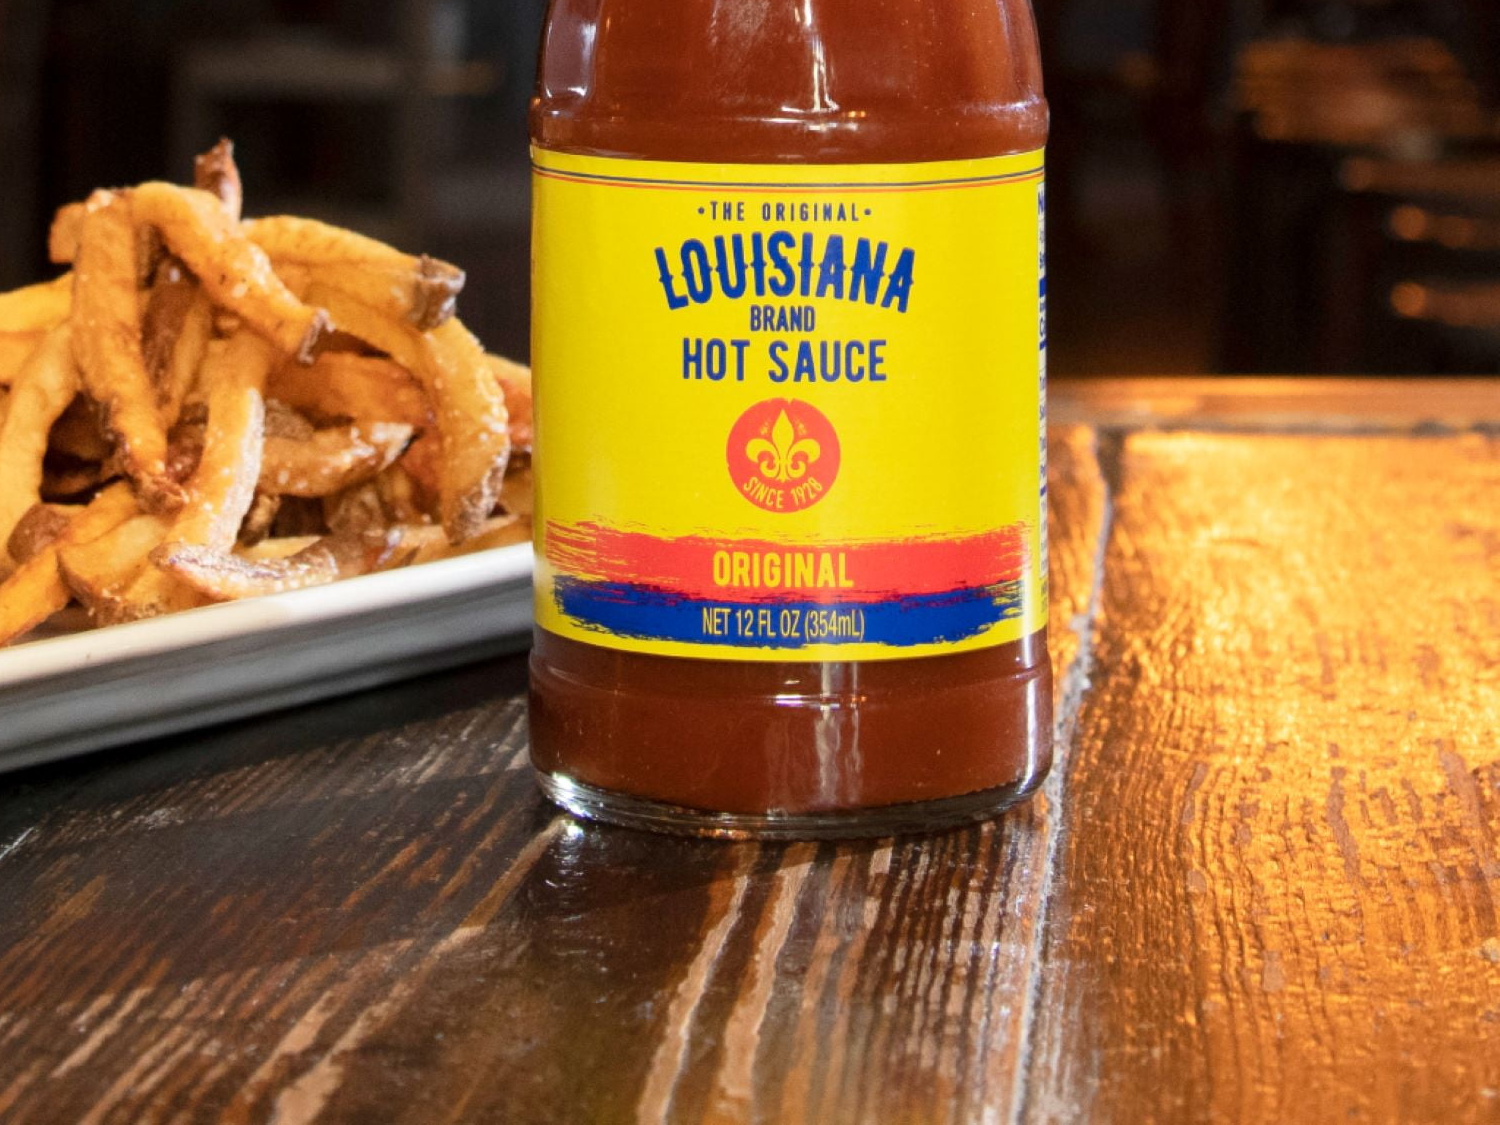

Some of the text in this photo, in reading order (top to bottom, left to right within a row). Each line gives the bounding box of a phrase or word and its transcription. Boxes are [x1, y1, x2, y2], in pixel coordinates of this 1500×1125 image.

[710, 201, 859, 222] THE ORIGINAL
[655, 230, 916, 313] LOUISIANA
[749, 305, 816, 333] BRAND
[682, 337, 887, 383] HOT SAUCE
[743, 476, 823, 509] SINCE 1928
[713, 549, 855, 588] ORIGINAL
[702, 607, 865, 642] NET 12 FL OZ (354mL)
